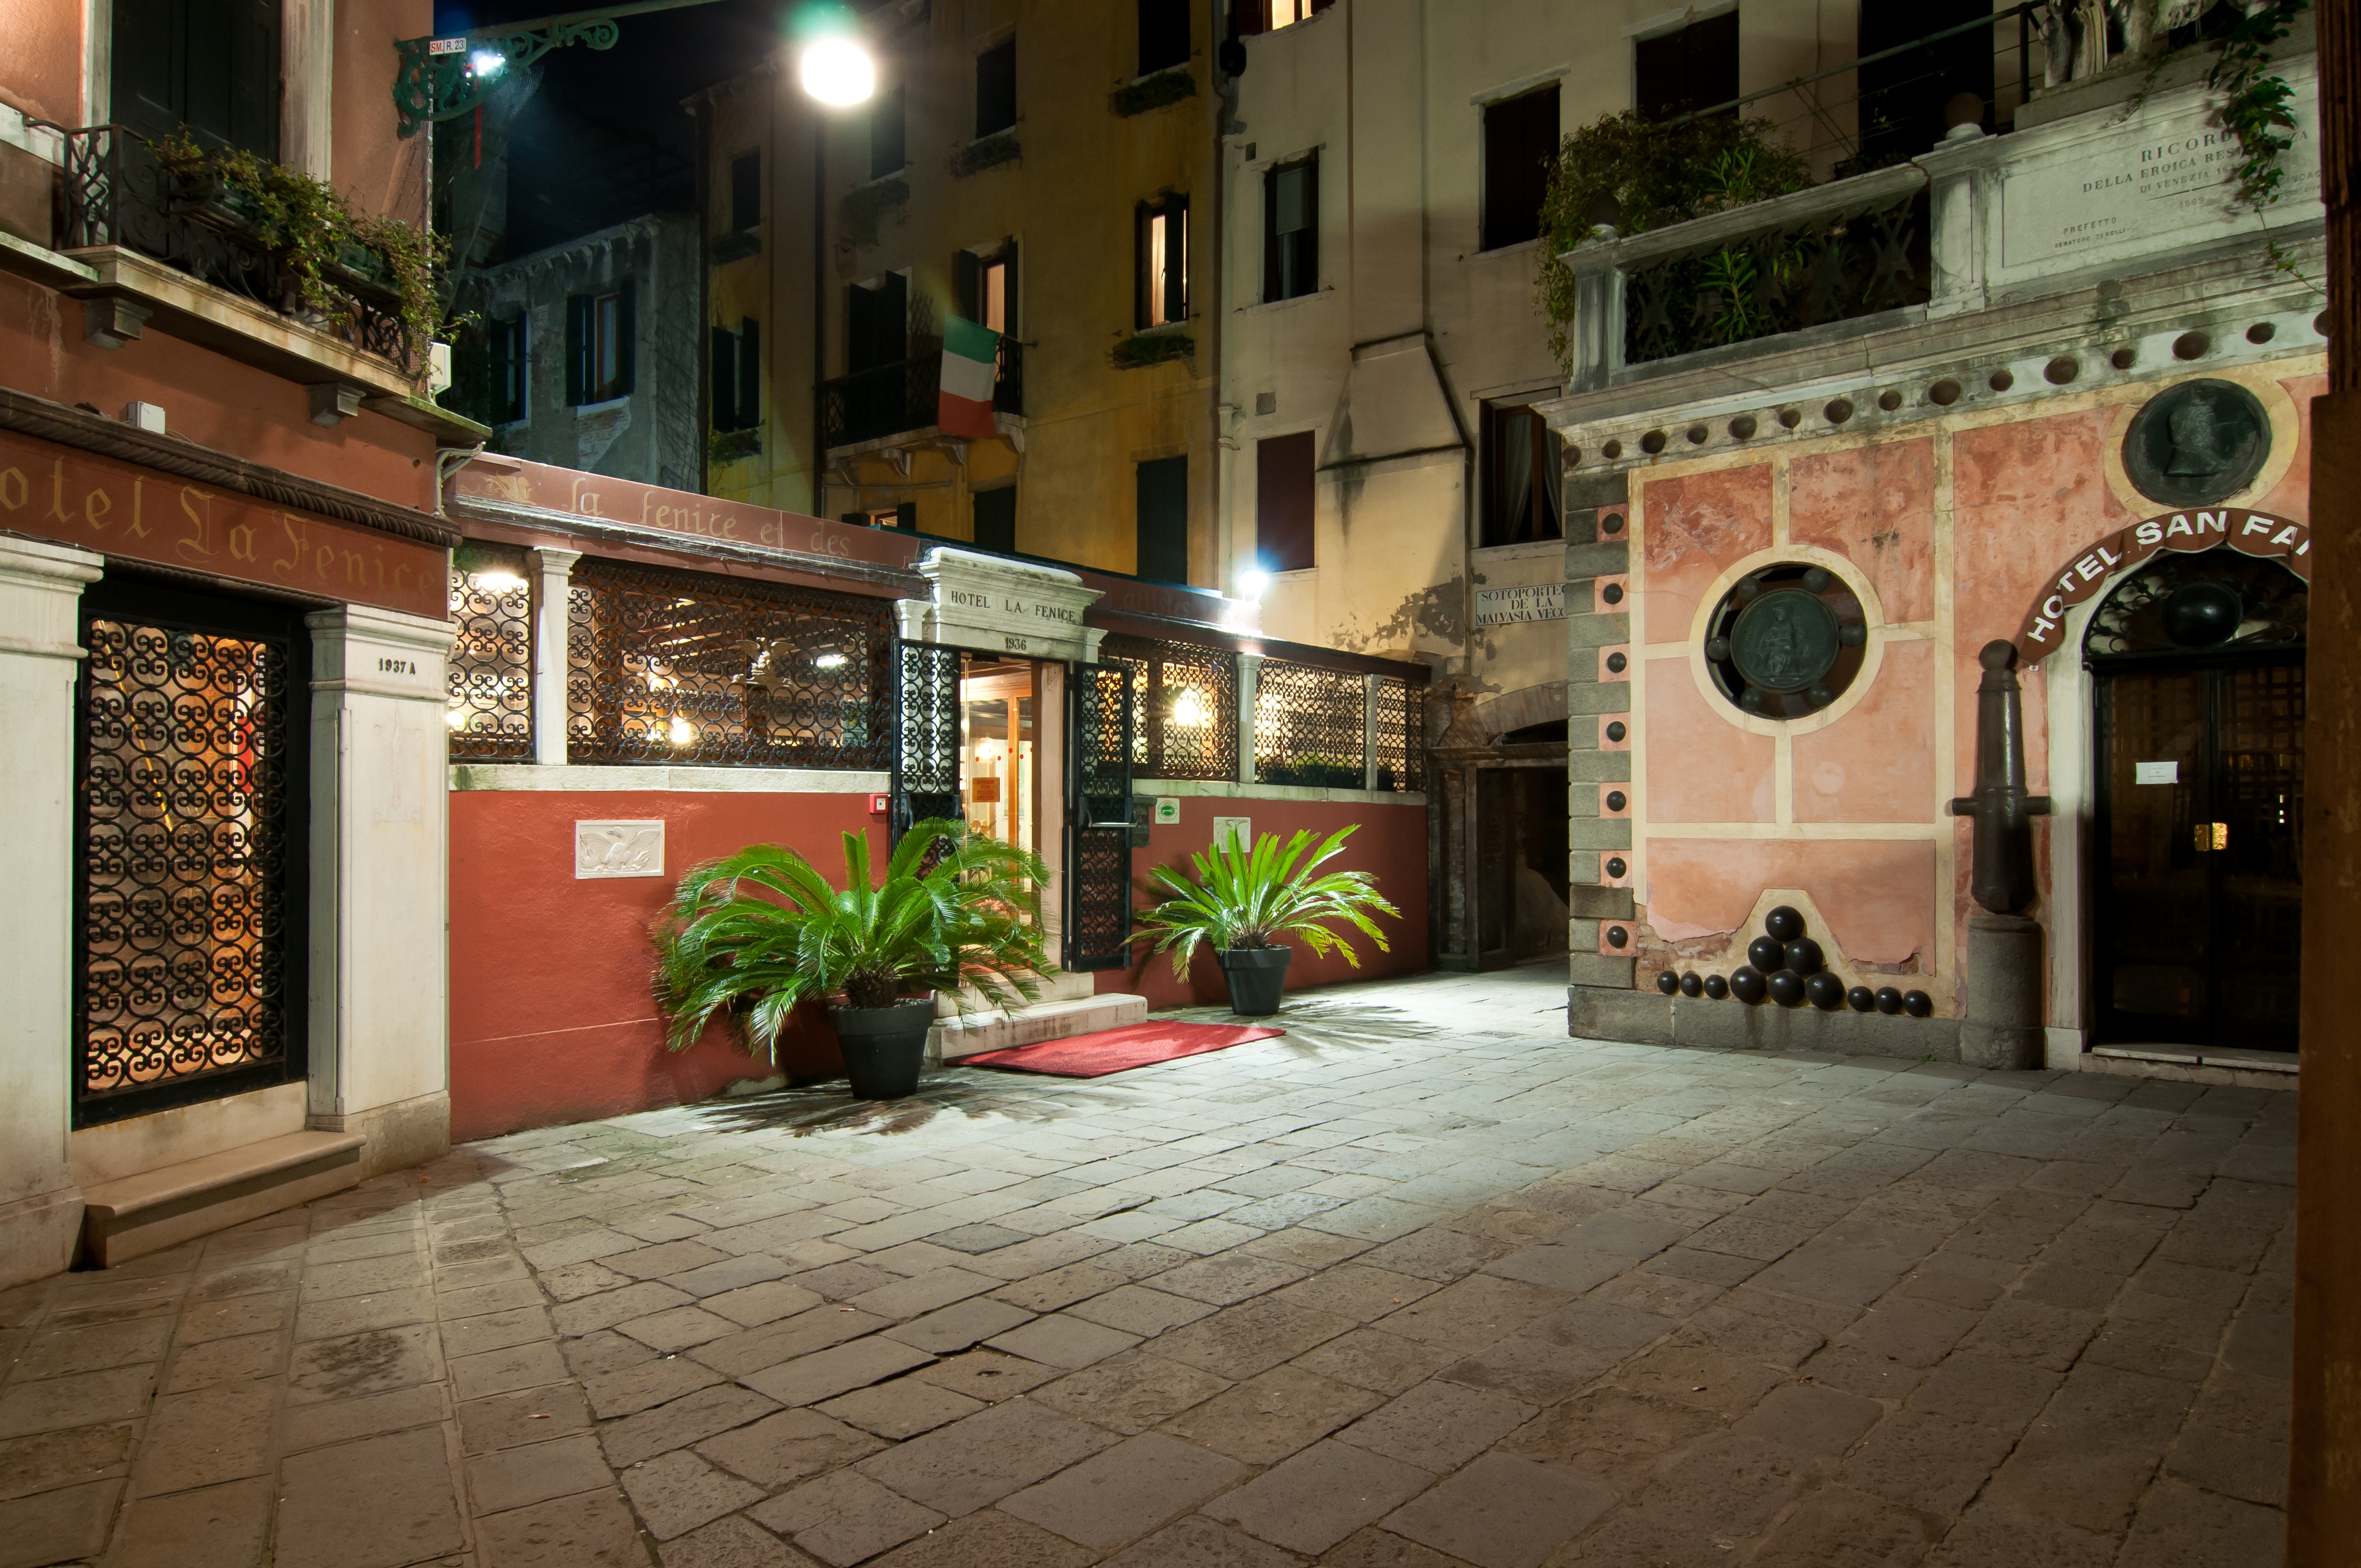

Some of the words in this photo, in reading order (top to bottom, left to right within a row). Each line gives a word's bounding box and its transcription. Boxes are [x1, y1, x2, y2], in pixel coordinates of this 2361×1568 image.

[455, 40, 464, 50] 23
[2083, 173, 2133, 193] DELLA
[2140, 157, 2196, 179] EROICA
[2157, 171, 2209, 188] VENEZIA
[2180, 197, 2205, 209] 1869
[2063, 216, 2117, 235] PREFETTO
[2054, 236, 2091, 248] SENATORE
[569, 477, 603, 516] la
[640, 490, 738, 539] fenice
[760, 521, 785, 549] et
[810, 521, 851, 557] des
[176, 485, 260, 564] La
[273, 509, 436, 598] Fenice
[2027, 547, 2122, 643] HOTEL
[2135, 511, 2227, 545] SAN
[951, 590, 991, 608] HOTEL
[1005, 599, 1022, 613] LA
[1036, 605, 1075, 622] FENICE
[1511, 598, 1528, 610] DE
[1536, 597, 1553, 608] LA
[1477, 610, 1532, 624] MALVASIA
[1537, 607, 1565, 619] VECC
[1005, 636, 1027, 651] 1936
[379, 657, 406, 673] 1937
[409, 662, 416, 675] A
